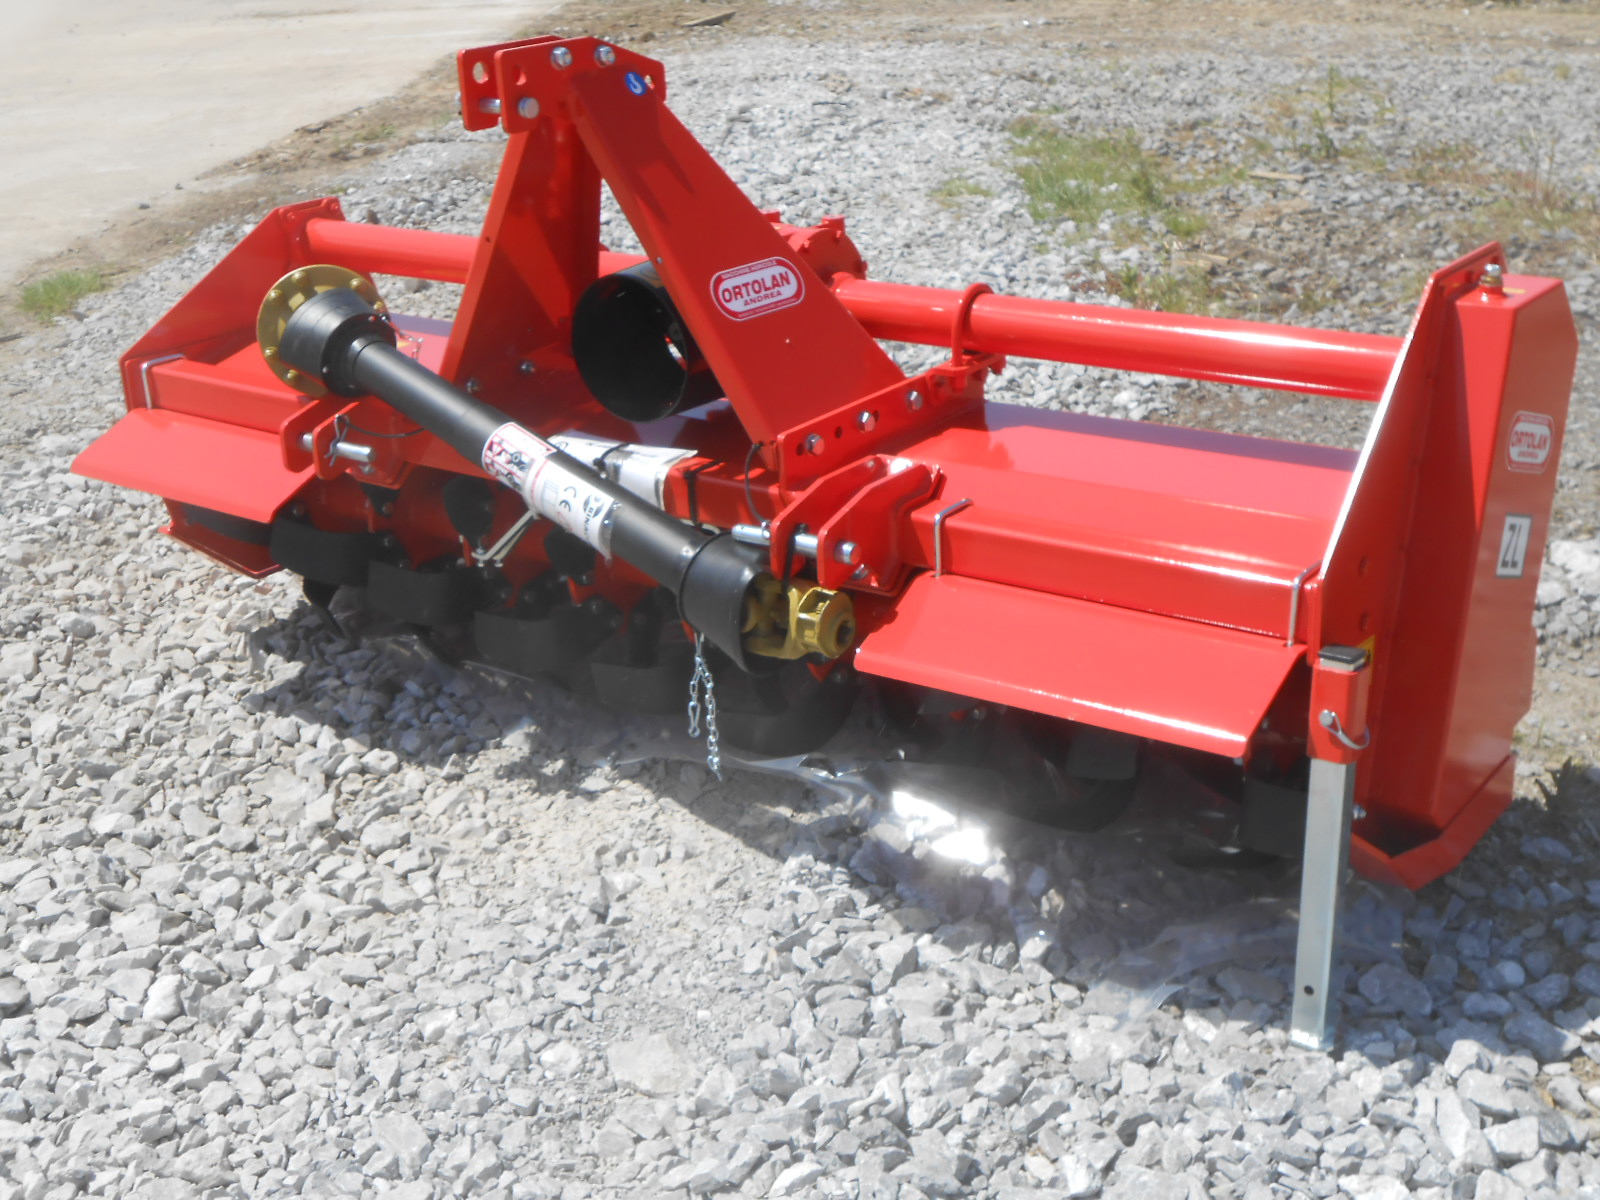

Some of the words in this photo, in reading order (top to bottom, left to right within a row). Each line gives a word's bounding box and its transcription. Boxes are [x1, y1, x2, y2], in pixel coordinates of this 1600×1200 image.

[722, 271, 791, 303] ORTOLAN
[743, 290, 782, 306] ANDREA
[1511, 430, 1548, 450] ORTOLAN
